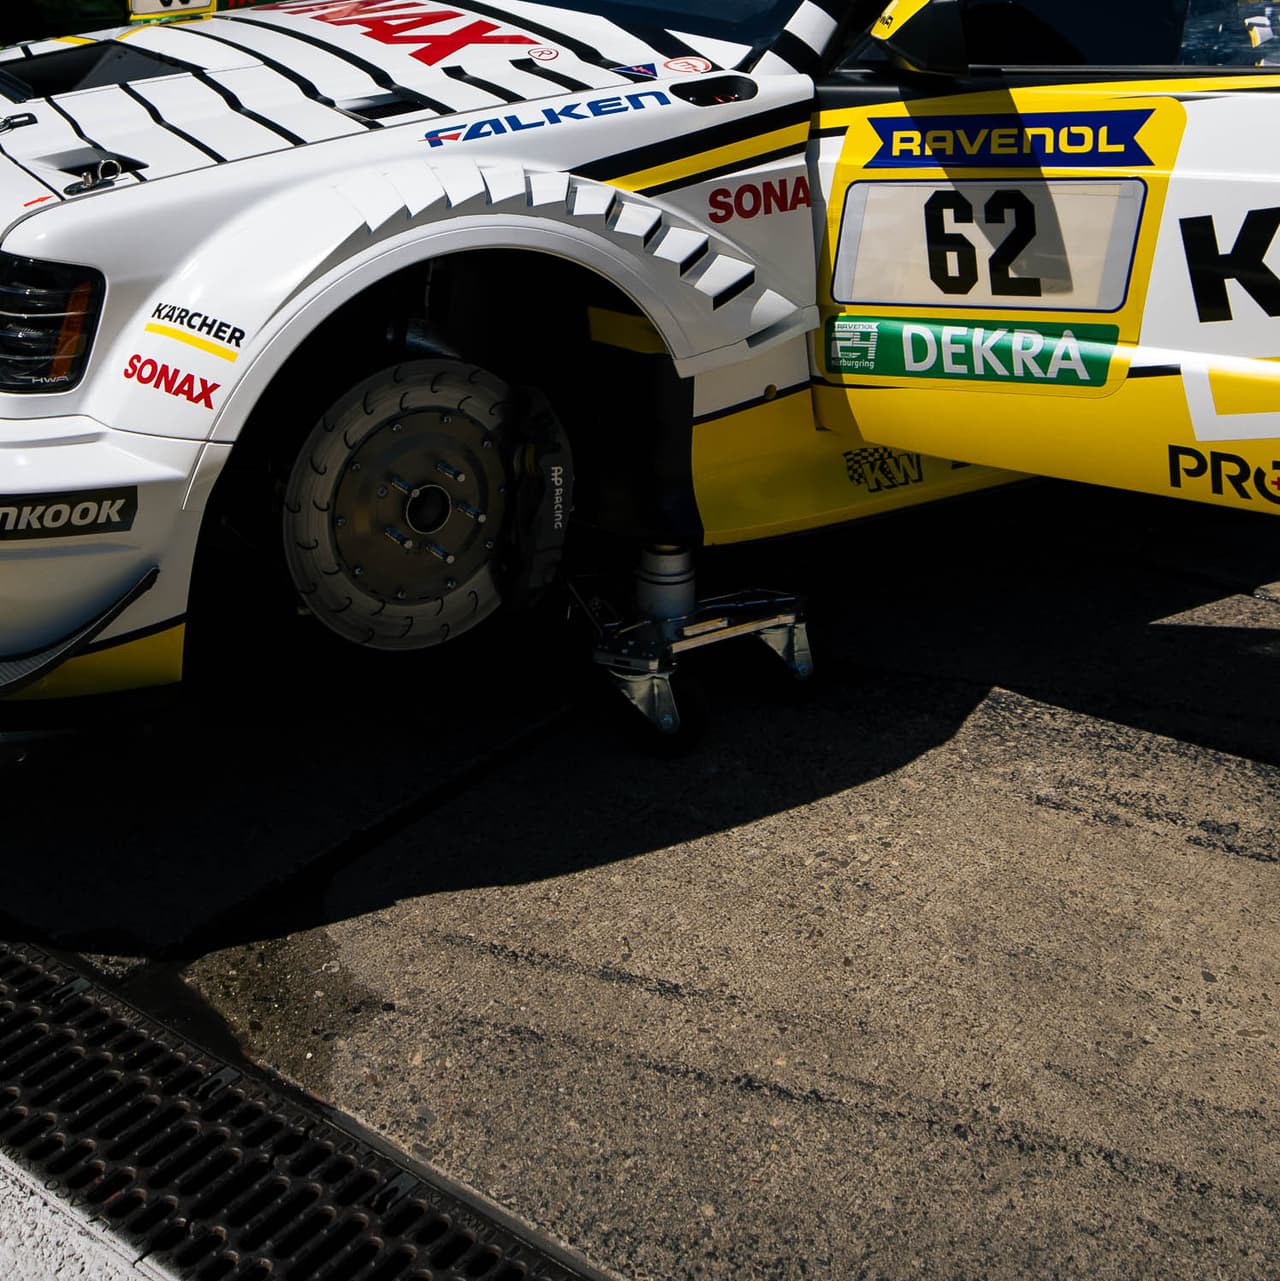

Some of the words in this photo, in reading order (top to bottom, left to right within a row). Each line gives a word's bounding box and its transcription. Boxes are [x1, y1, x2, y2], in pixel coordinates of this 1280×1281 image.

[424, 89, 672, 148] FALKEN
[891, 125, 1127, 157] RAVENOL
[923, 190, 1042, 298] 62
[151, 302, 246, 349] KÄRCHER
[902, 324, 1090, 382] DEKRA
[30, 374, 71, 384] HWA
[124, 353, 222, 410] SONAX
